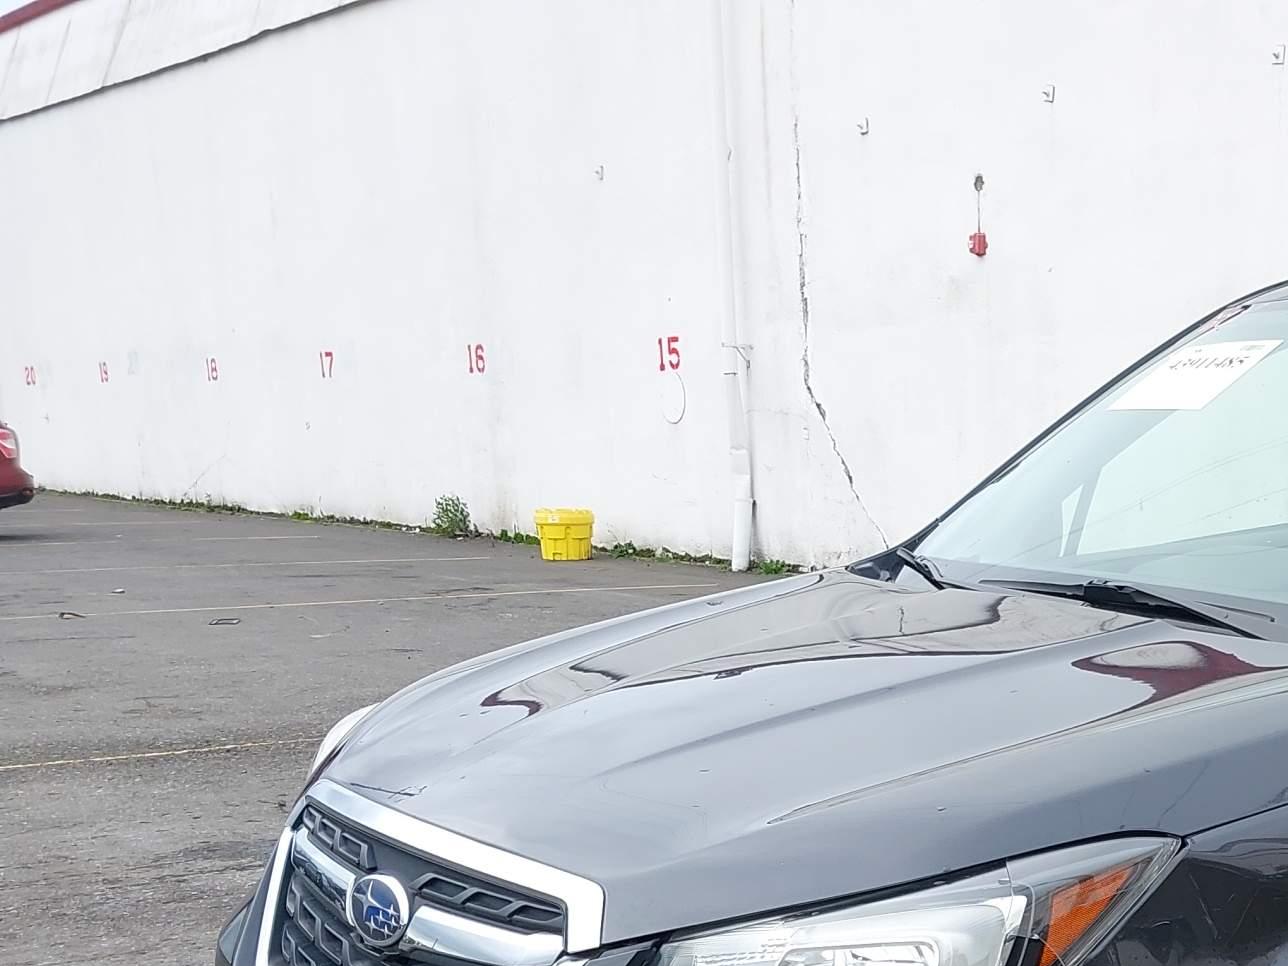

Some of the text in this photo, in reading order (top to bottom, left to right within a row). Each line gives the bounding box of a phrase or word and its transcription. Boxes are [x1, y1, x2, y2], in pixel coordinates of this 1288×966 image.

[319, 351, 334, 378] 17
[466, 344, 486, 374] 16
[656, 336, 681, 372] 15
[24, 366, 37, 387] 20
[205, 357, 220, 383] 18
